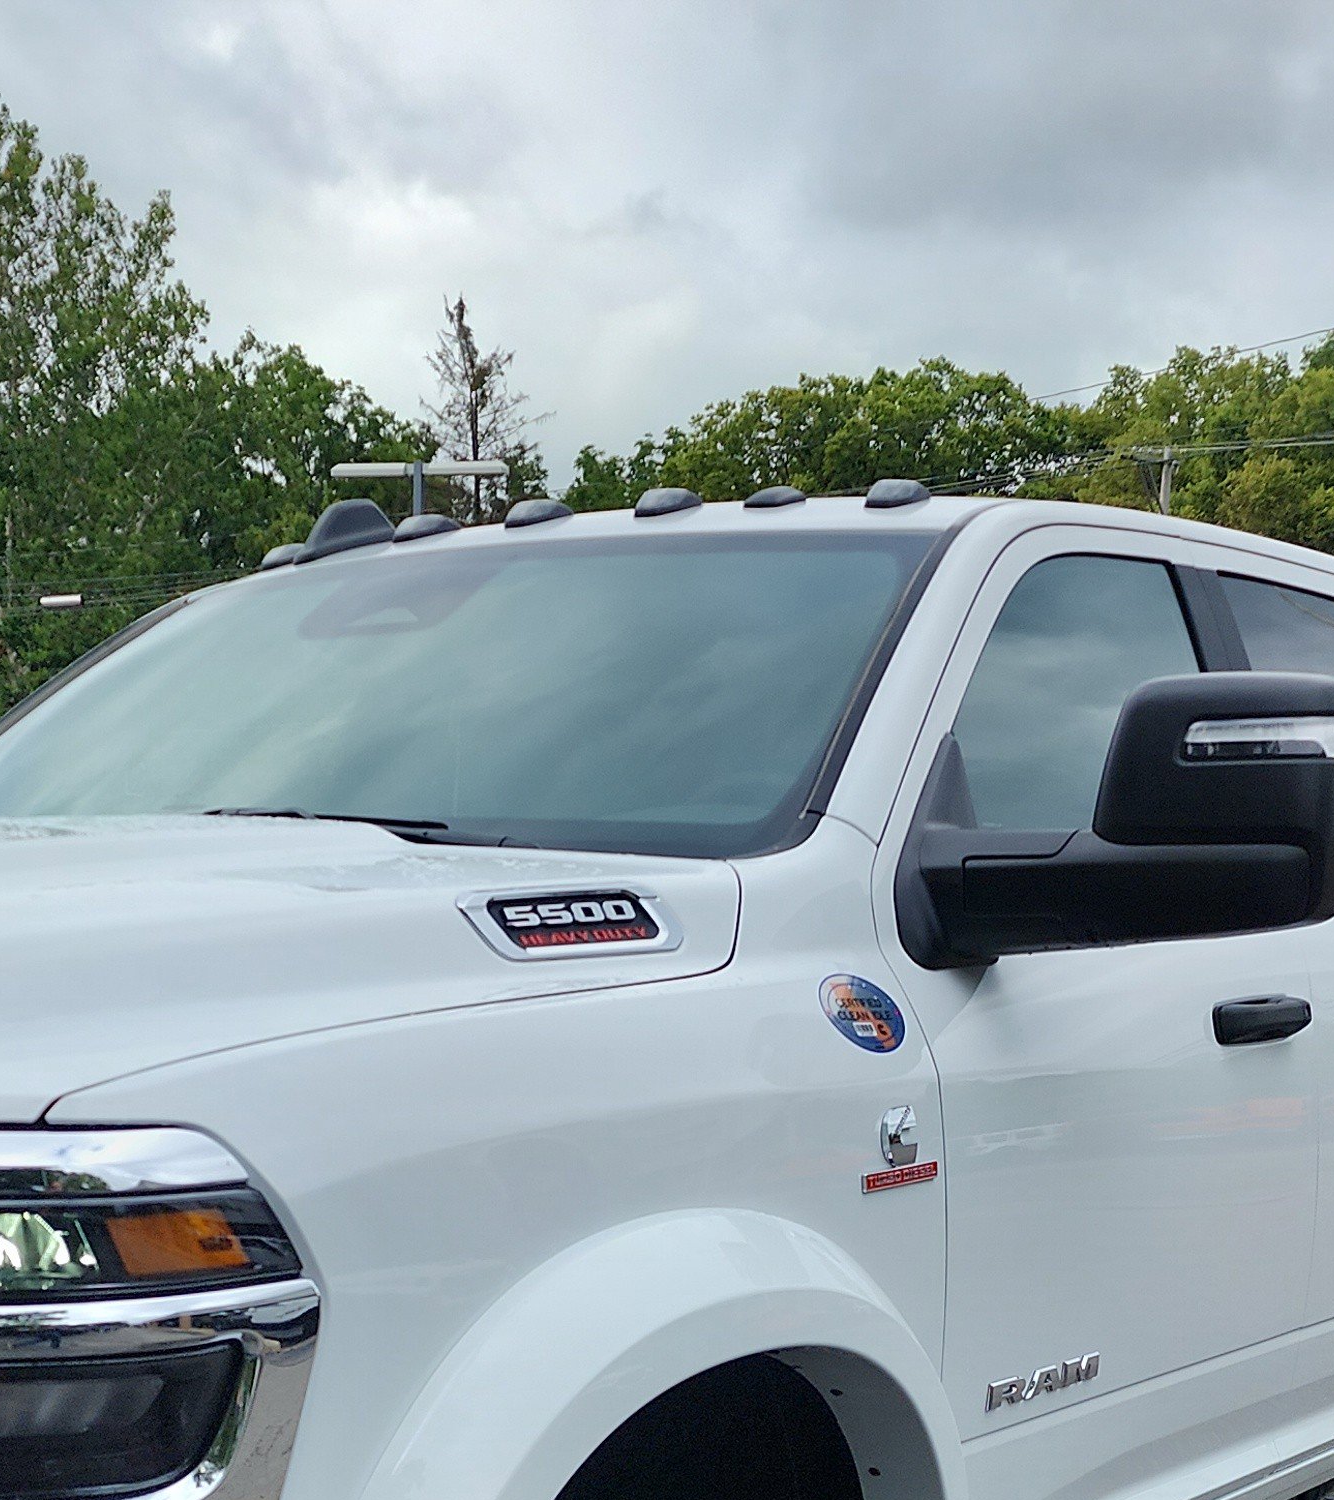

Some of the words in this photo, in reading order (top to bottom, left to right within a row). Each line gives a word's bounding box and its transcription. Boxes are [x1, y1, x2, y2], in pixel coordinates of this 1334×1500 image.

[503, 899, 636, 927] 5500
[519, 930, 588, 945] HEAVY
[592, 926, 646, 940] DUTY
[984, 1351, 1101, 1413] RAM
